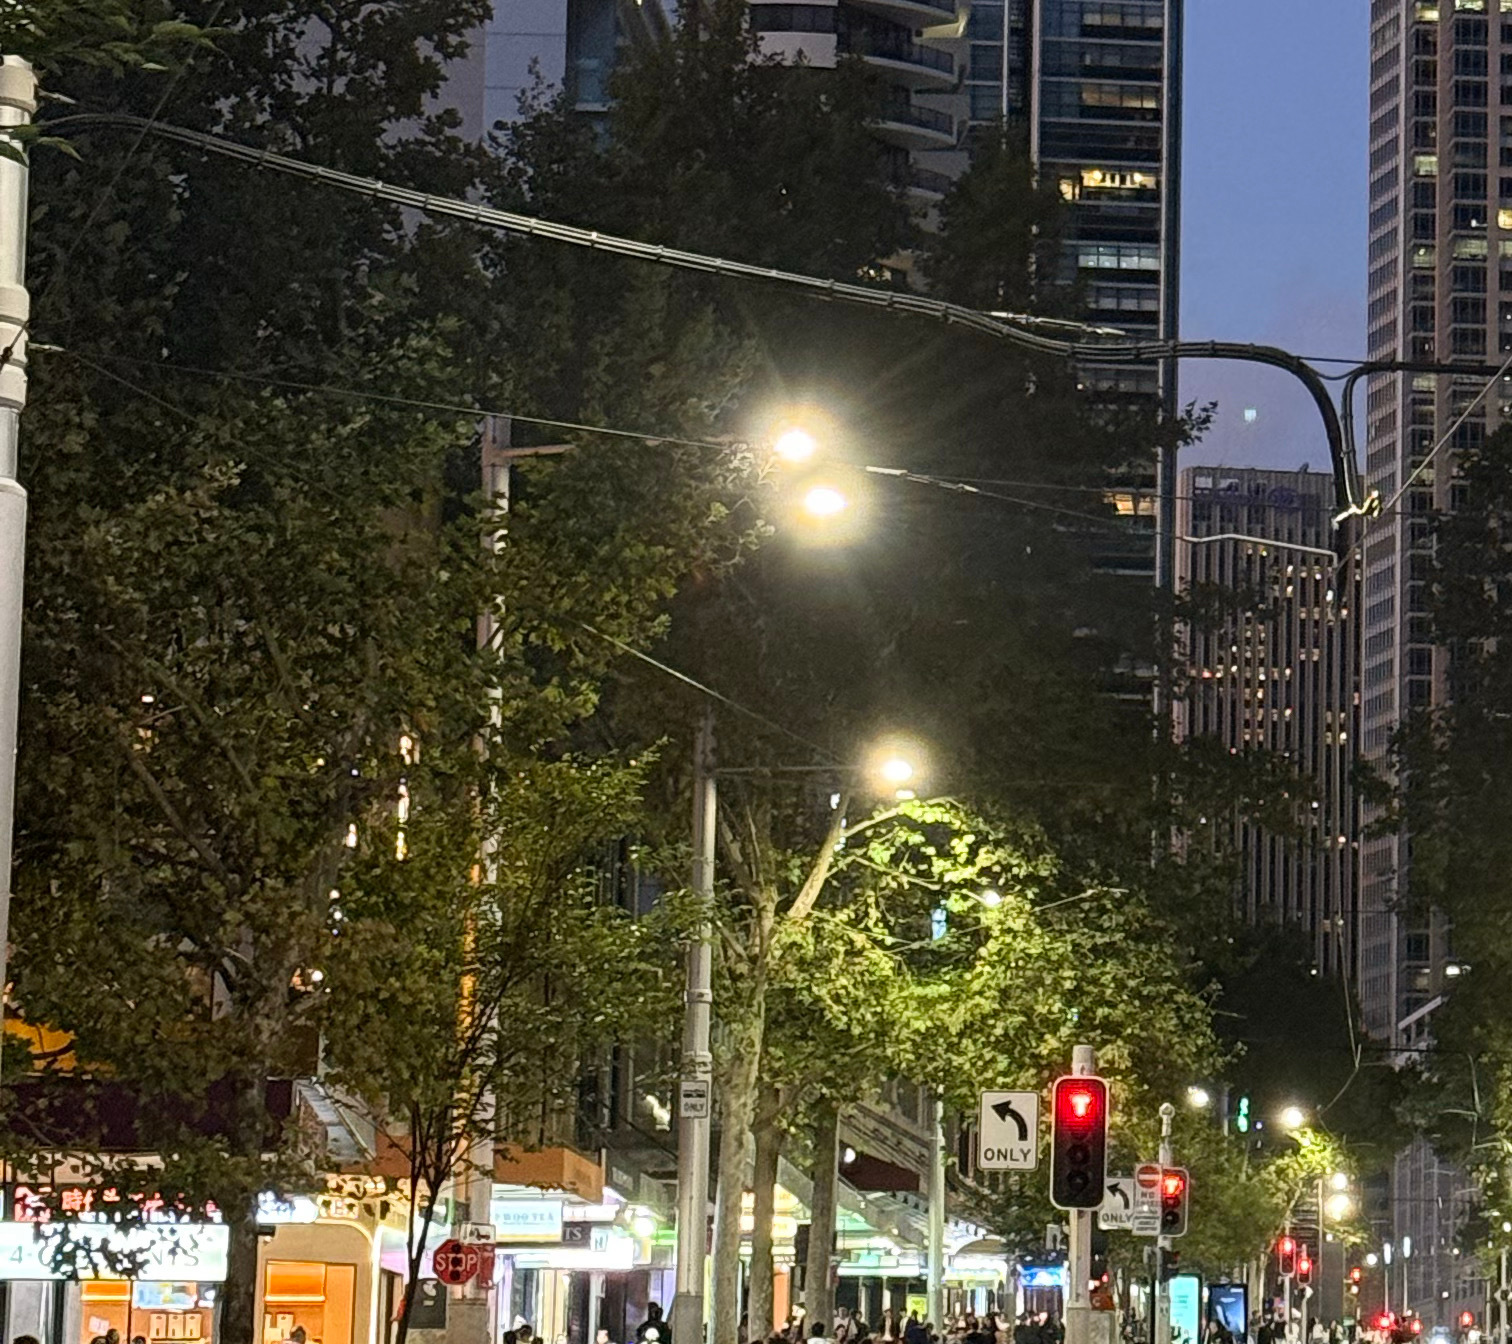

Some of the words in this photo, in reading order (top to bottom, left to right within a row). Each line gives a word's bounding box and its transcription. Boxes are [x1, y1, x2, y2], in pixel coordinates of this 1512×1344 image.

[983, 1147, 1032, 1163] ONLY
[1101, 1212, 1133, 1223] ONLY
[435, 1253, 478, 1272] STOP
